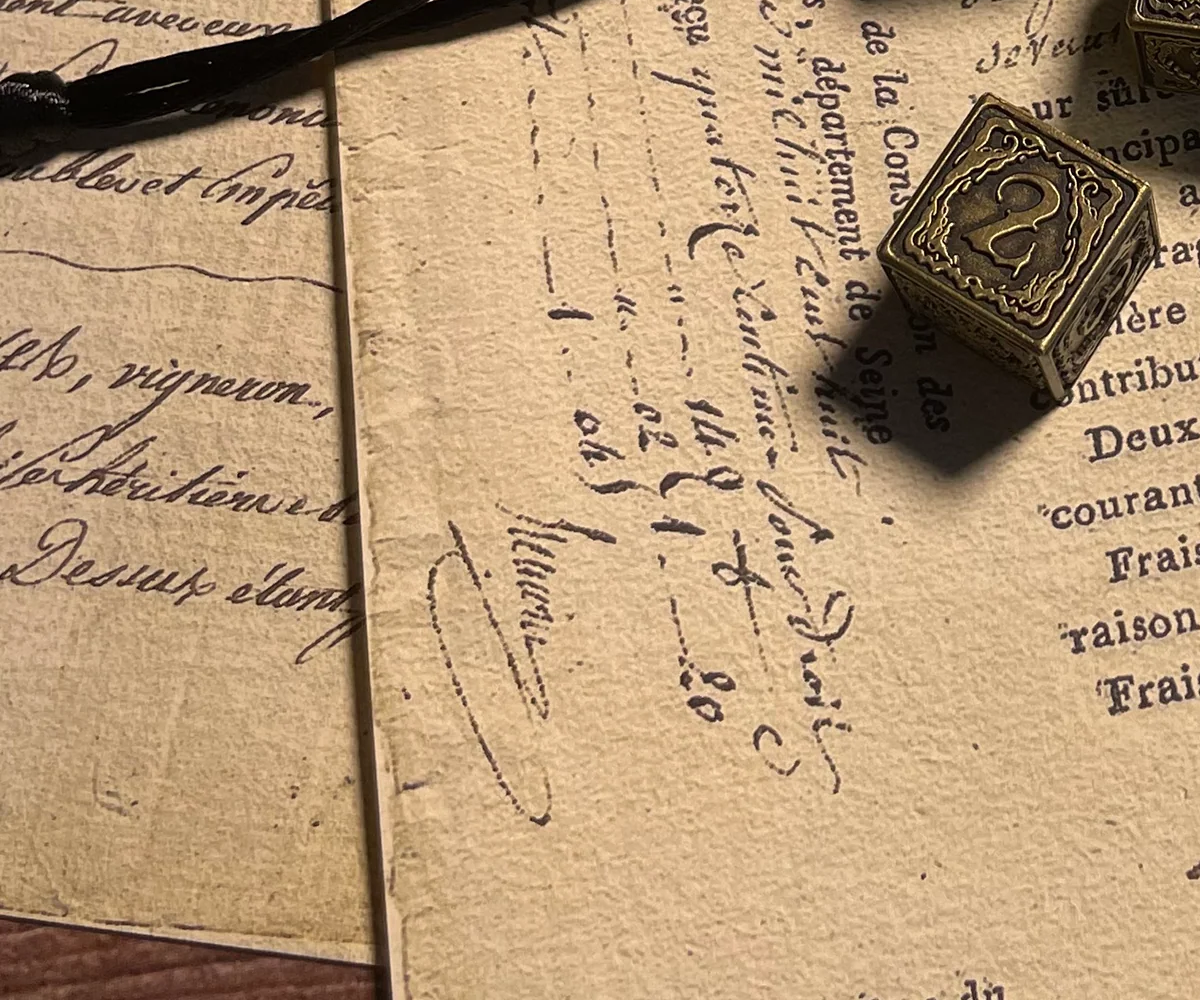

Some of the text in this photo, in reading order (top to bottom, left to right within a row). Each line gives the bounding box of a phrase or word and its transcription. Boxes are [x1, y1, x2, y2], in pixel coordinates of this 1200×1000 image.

[860, 19, 896, 57] de
[872, 71, 909, 109] la
[811, 56, 869, 262] département
[961, 171, 1061, 280] 2
[845, 280, 874, 323] de
[853, 346, 894, 446] Seine
